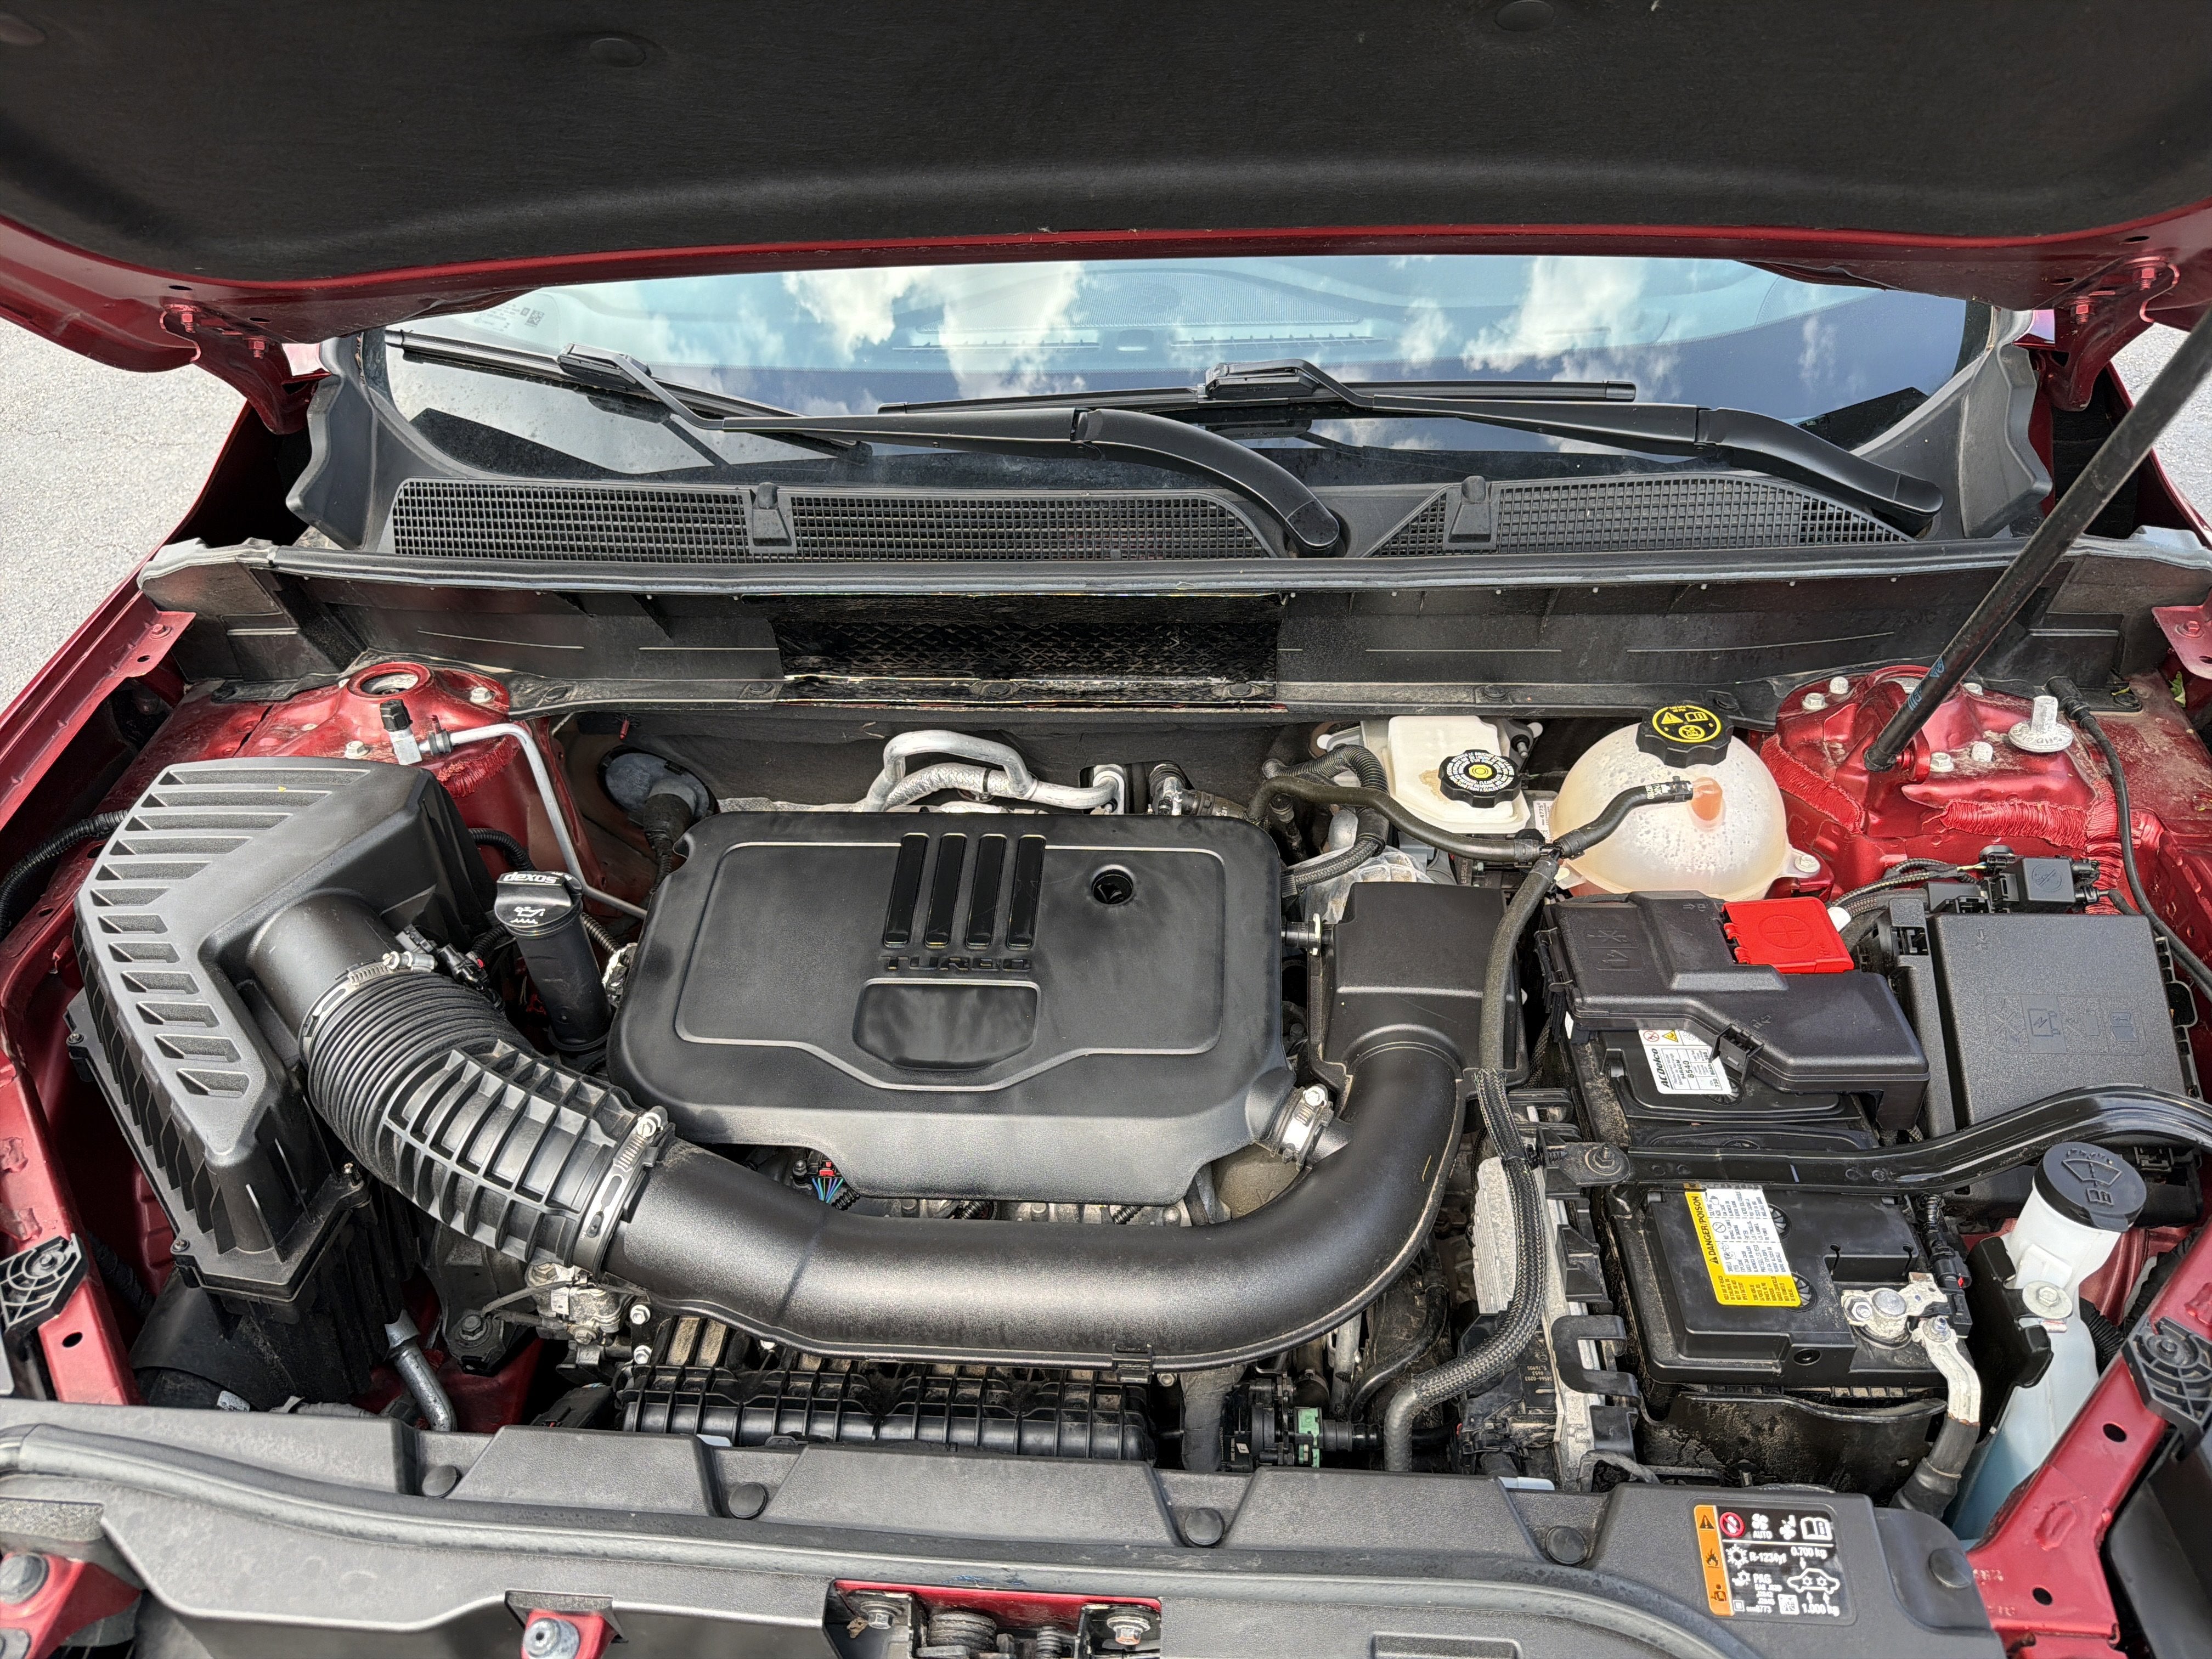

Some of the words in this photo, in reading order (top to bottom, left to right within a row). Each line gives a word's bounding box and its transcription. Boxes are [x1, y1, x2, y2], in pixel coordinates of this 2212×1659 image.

[503, 872, 558, 884] dexos
[879, 956, 1032, 973] TURBO
[1651, 1048, 1669, 1088] ACDelco
[1683, 1060, 1694, 1079] 8540
[1692, 1196, 1717, 1256] DANGER/POISON
[1753, 1531, 1773, 1539] AUTO
[1750, 1552, 1787, 1565] R-1234yf
[1791, 1547, 1814, 1557] 0.700
[1814, 1548, 1828, 1559] kg
[1753, 1573, 1772, 1584] PAG
[1802, 1603, 1826, 1615] 1.000
[1826, 1604, 1840, 1617] kg
